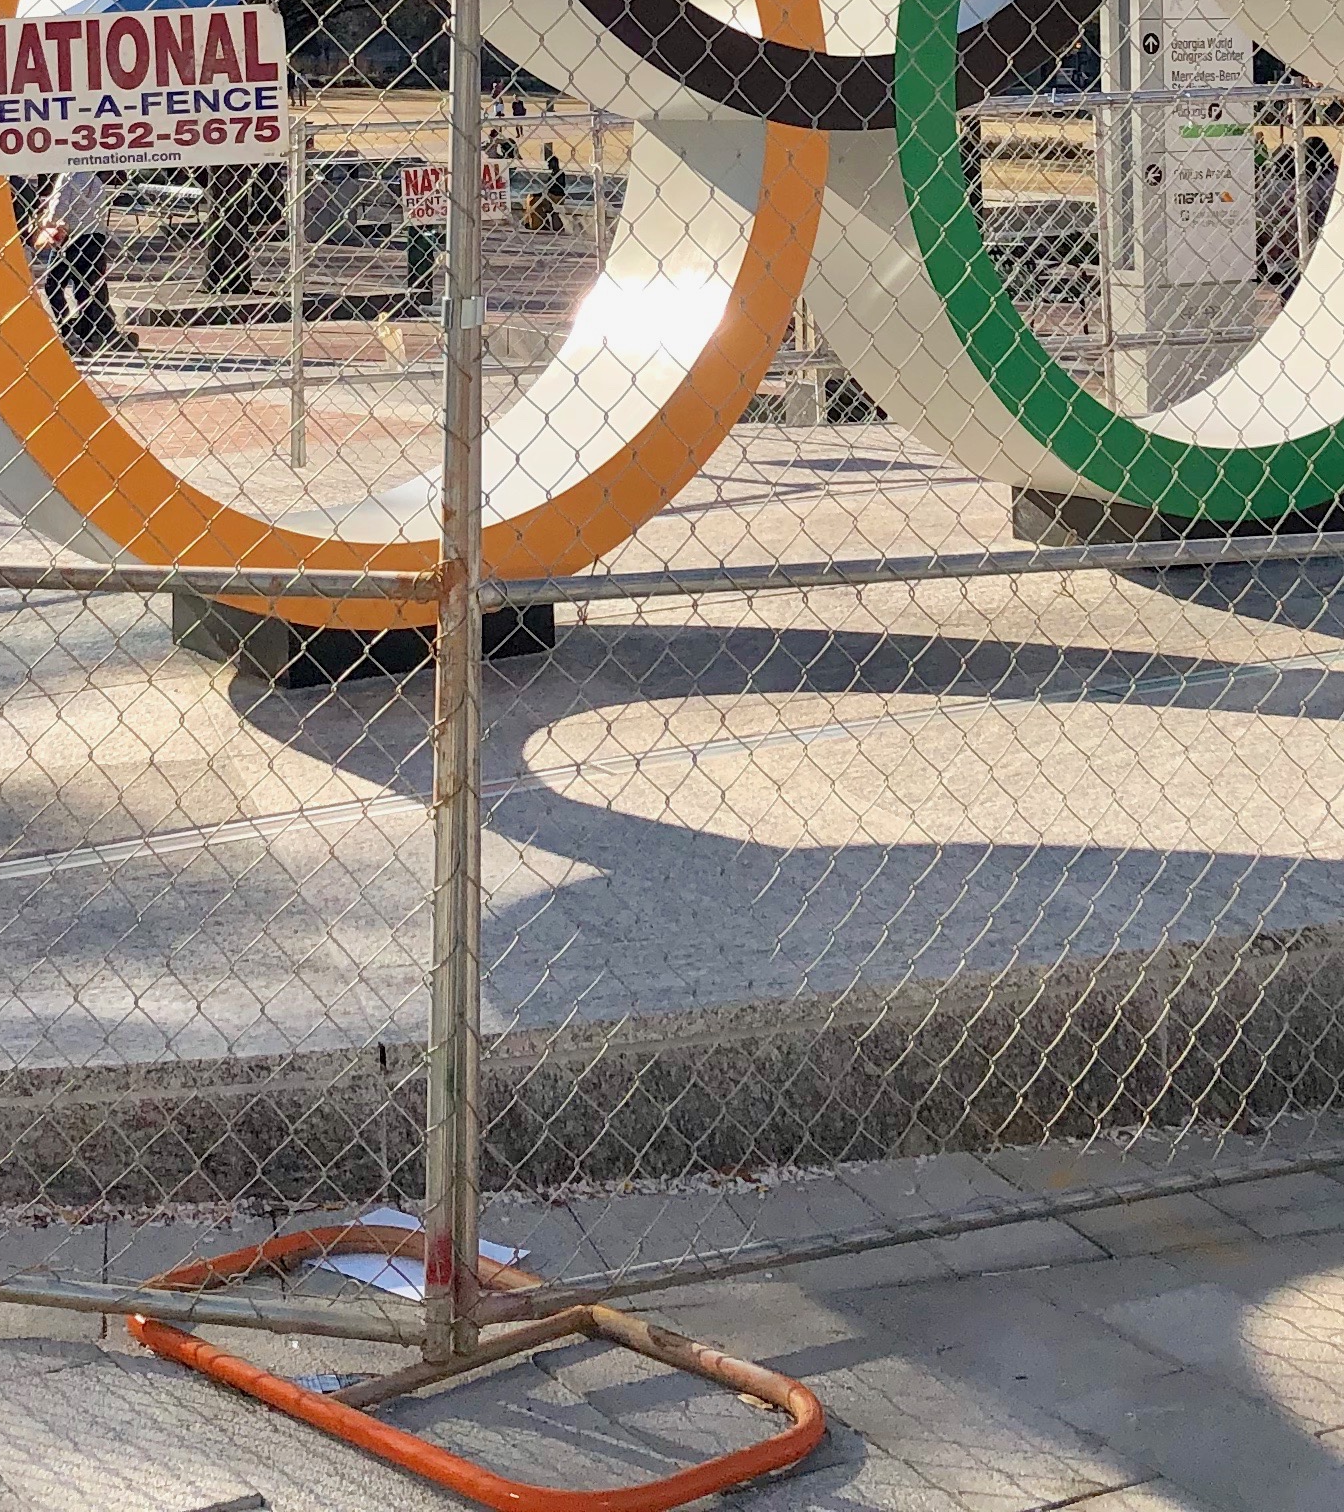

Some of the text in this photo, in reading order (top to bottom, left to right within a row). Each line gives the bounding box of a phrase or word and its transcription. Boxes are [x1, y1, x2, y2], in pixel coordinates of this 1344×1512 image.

[1171, 38, 1206, 51] Georgia
[1171, 49, 1244, 64] Congress Center
[67, 150, 181, 167] rentnational.com
